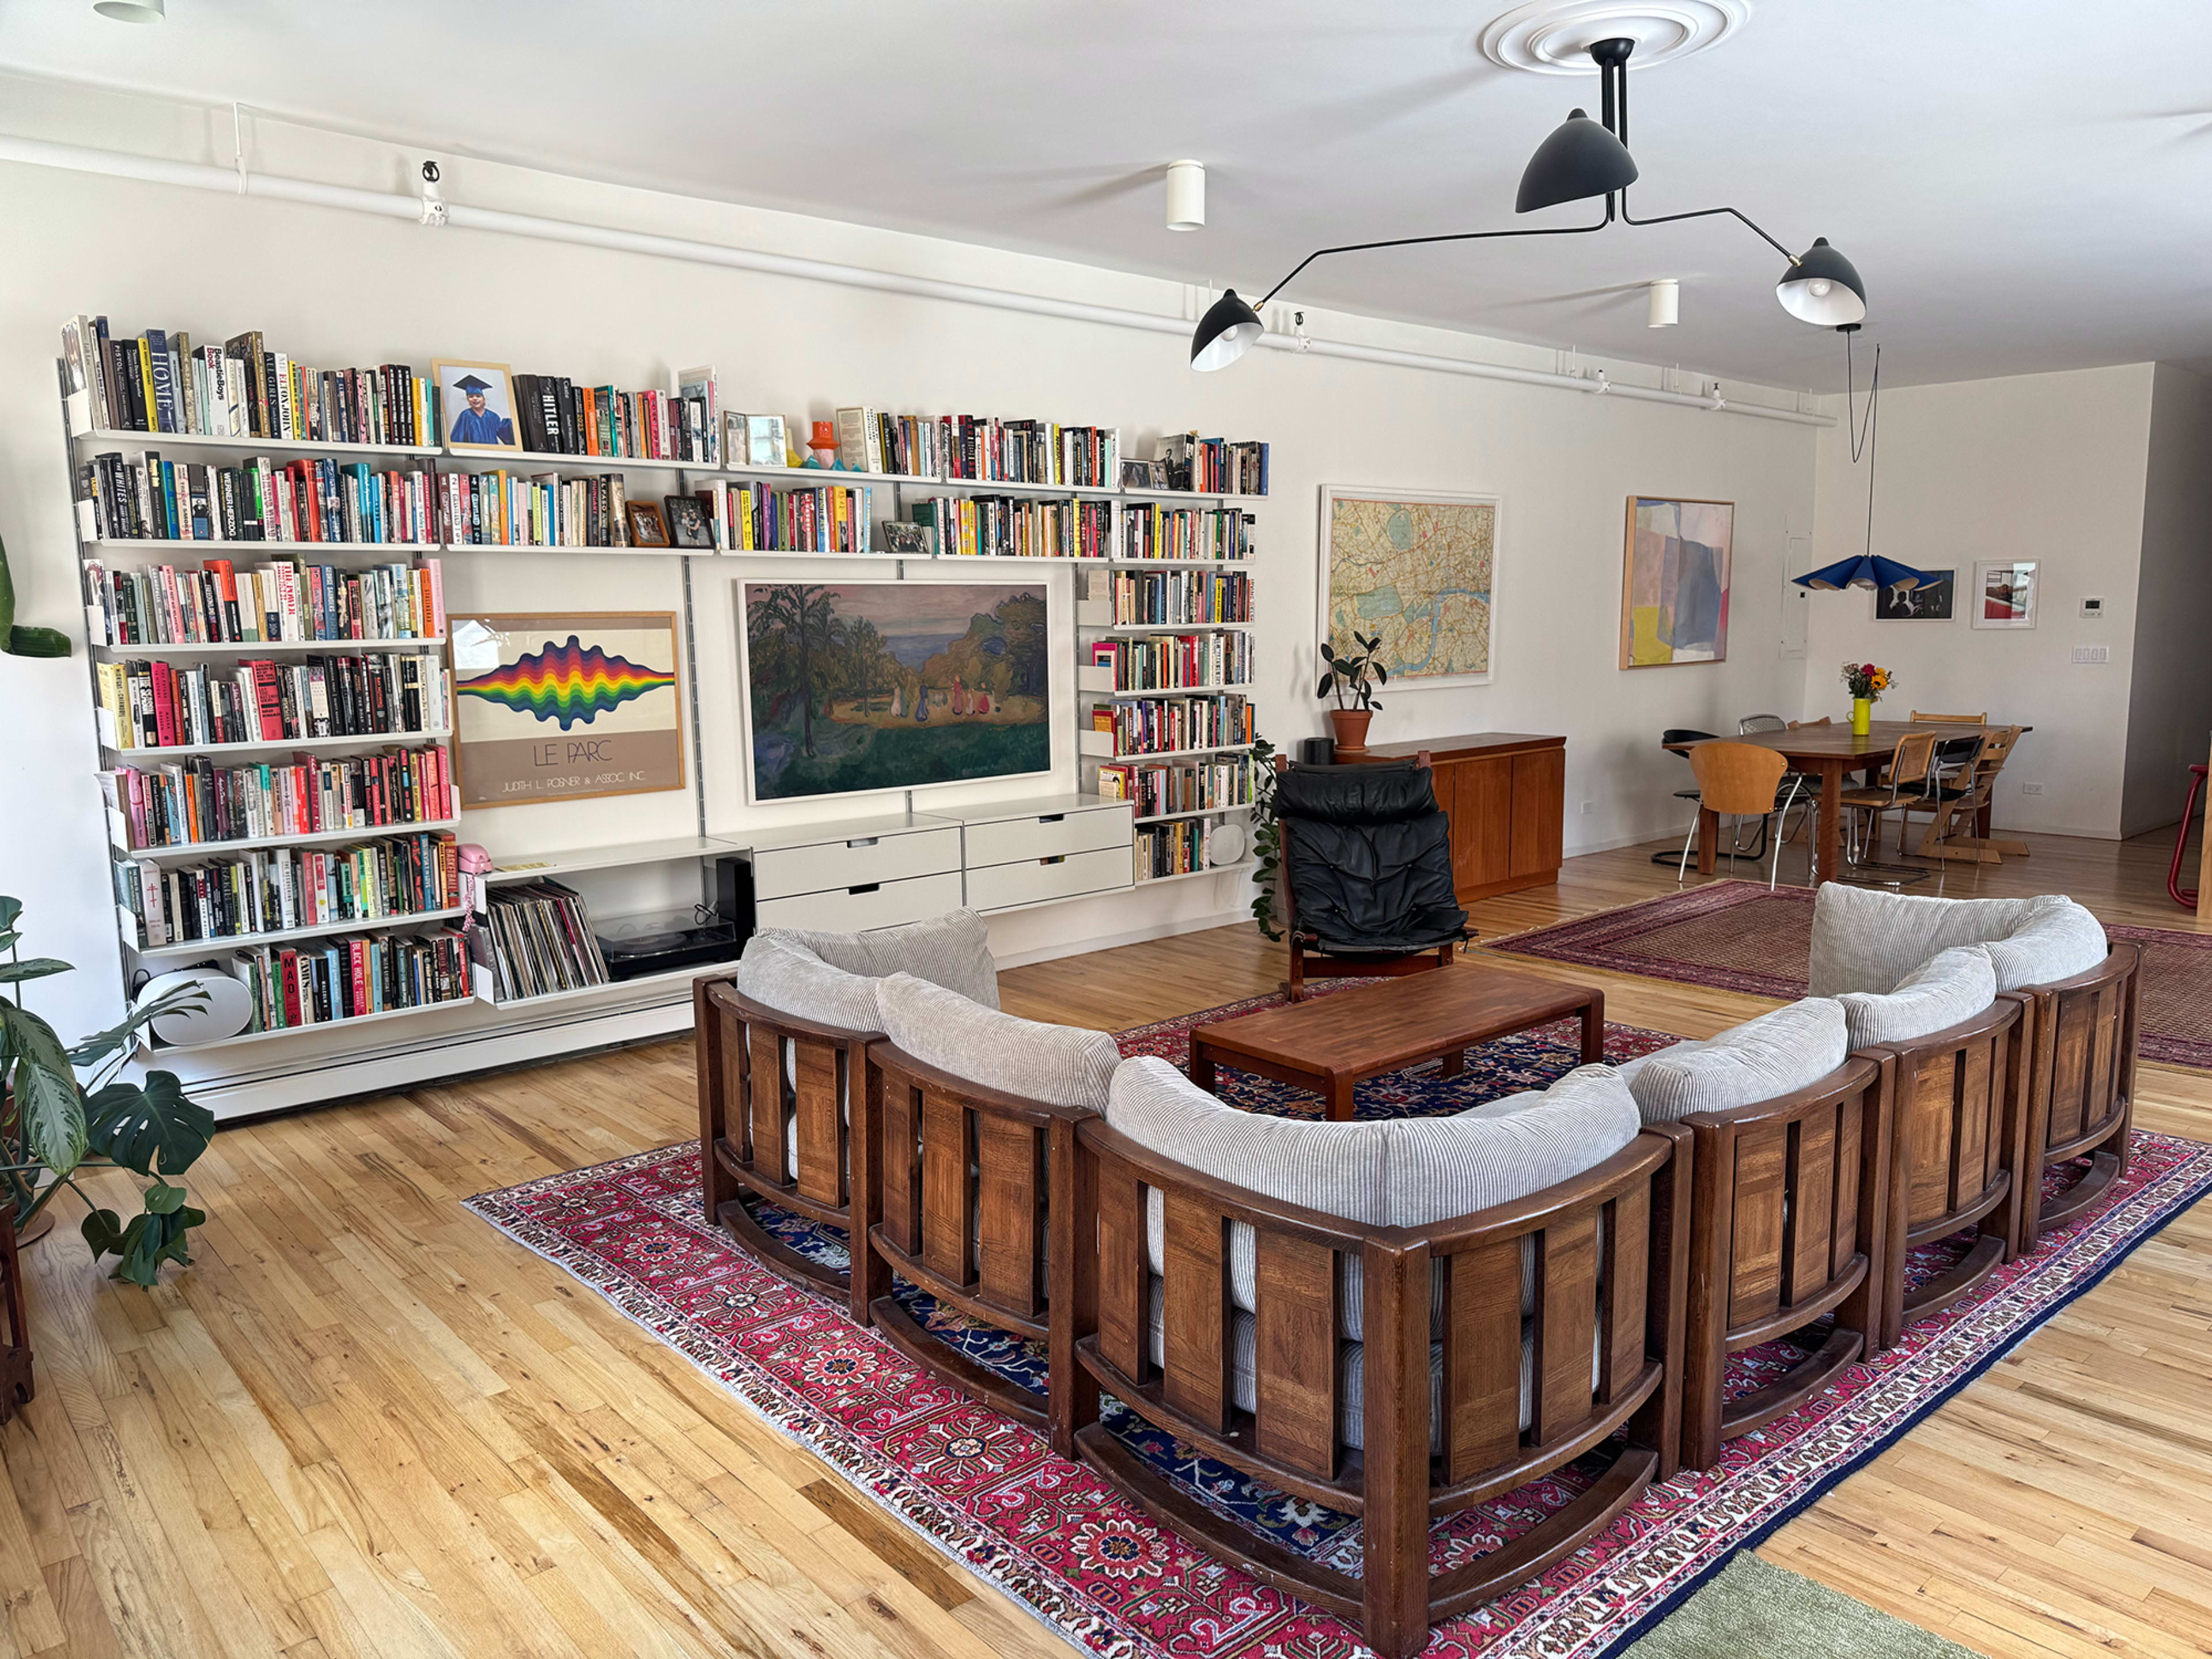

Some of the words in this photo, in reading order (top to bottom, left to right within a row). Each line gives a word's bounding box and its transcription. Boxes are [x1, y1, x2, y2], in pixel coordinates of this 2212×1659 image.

[115, 346, 123, 372] PISTOL
[266, 354, 274, 374] ALL
[152, 353, 173, 411] HOME
[267, 377, 277, 406] GIRLS
[279, 374, 289, 404] ELTON
[281, 405, 291, 432] JOHN
[543, 395, 559, 435] HITLER
[115, 472, 127, 503] WHITES
[224, 472, 233, 505] WERNER
[226, 506, 236, 537] HERZOG
[151, 568, 161, 603] COSMOPOLIS
[325, 567, 334, 585] GEORGE
[327, 588, 335, 612] SAUNDERS
[139, 676, 151, 690] THE
[533, 744, 558, 766] LE
[567, 740, 613, 764] PARC
[502, 780, 532, 793] JUDITH
[584, 777, 590, 785] &
[594, 771, 624, 784] ASSOC
[628, 770, 646, 781] INC
[222, 867, 232, 901] RAKIM
[446, 849, 457, 890] BASKETBALL
[351, 944, 361, 964] BLACK
[283, 957, 296, 994] MAO
[300, 957, 310, 988] CAMUS
[354, 967, 363, 985] HOLE
